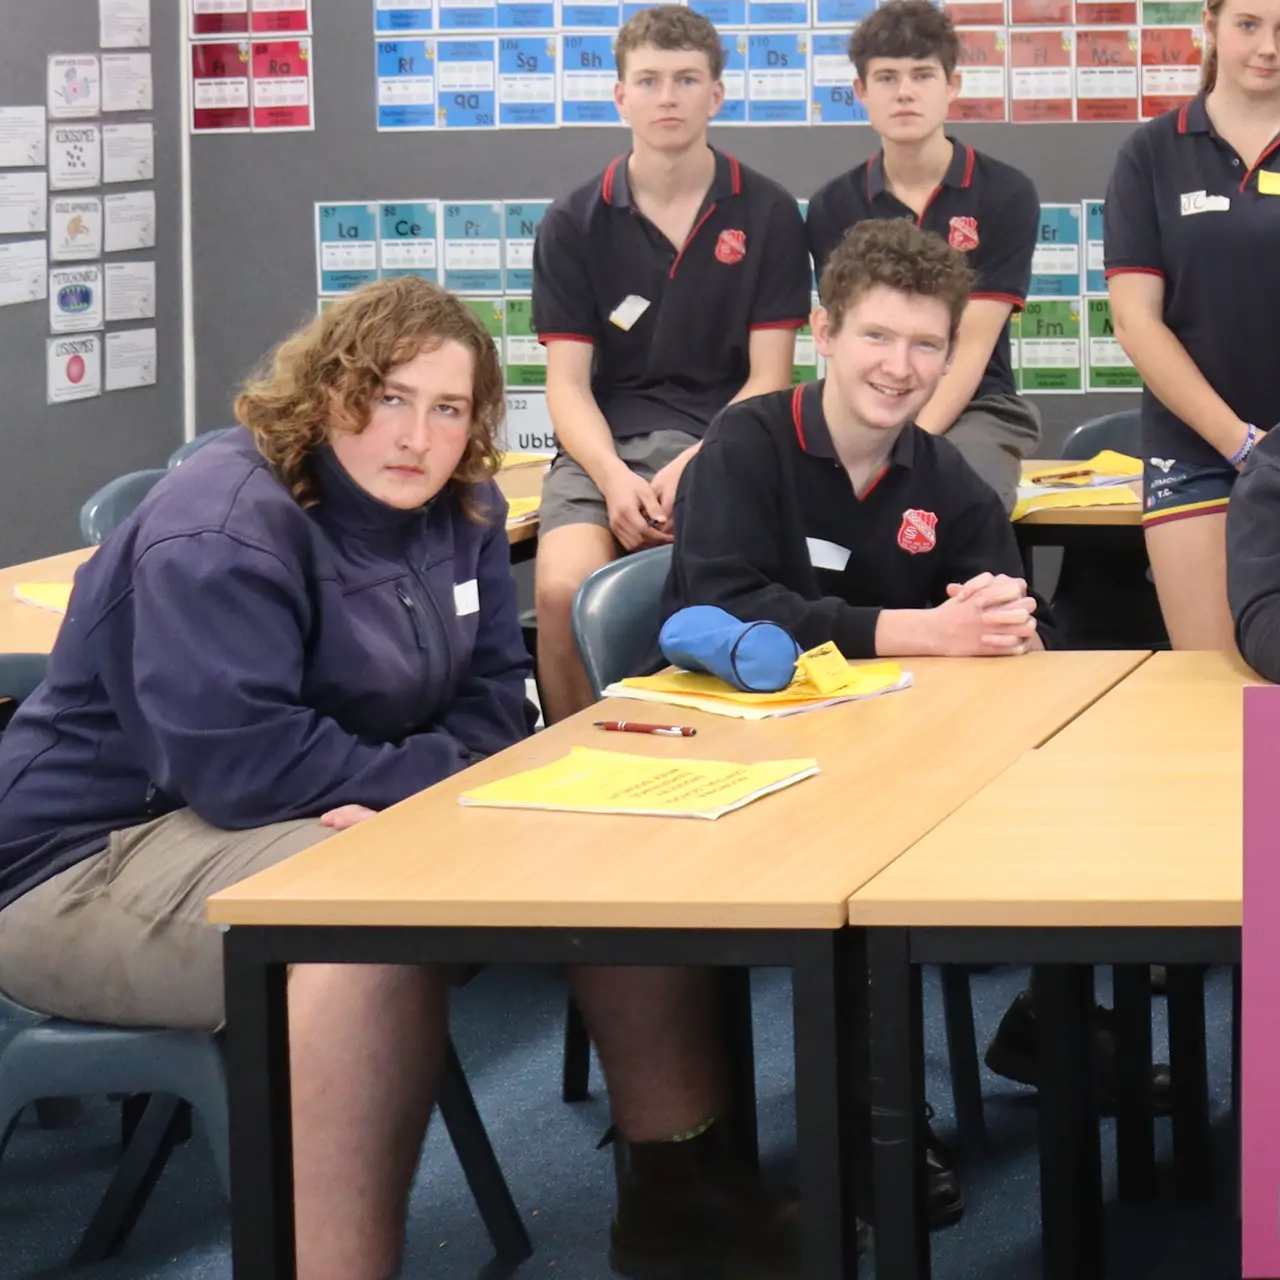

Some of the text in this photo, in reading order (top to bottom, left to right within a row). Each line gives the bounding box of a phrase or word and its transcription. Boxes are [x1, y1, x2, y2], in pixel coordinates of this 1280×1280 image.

[268, 59, 292, 76] Ra
[515, 51, 539, 72] Sg
[580, 50, 603, 68] Bh
[766, 50, 789, 68] Ds
[337, 222, 360, 238] La
[394, 219, 422, 237] Ce
[1040, 223, 1060, 242] Er
[1035, 317, 1065, 336] Fm
